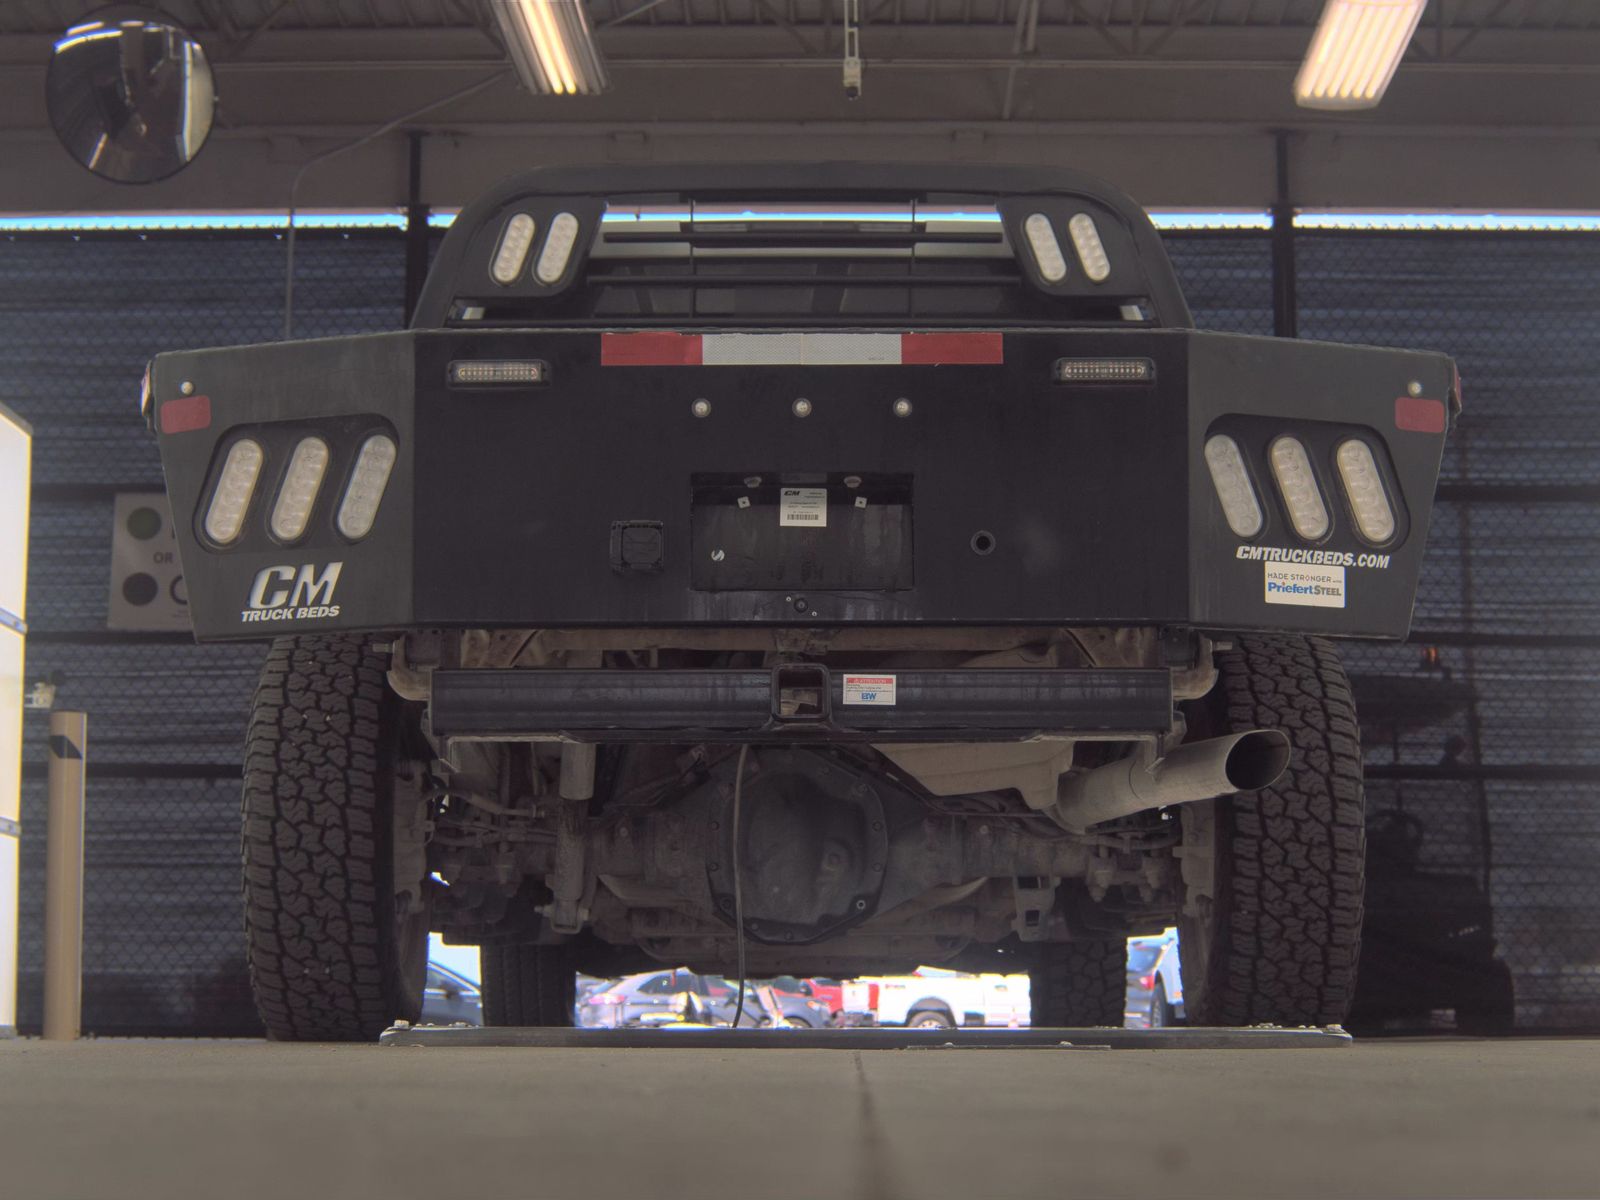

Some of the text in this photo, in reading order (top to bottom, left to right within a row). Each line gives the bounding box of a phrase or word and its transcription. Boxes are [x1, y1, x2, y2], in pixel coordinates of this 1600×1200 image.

[1236, 545, 1390, 569] CMTRUCKBEDS.COM
[249, 561, 343, 609] CM
[1290, 573, 1331, 583] STRONGER
[241, 605, 340, 622] TRUCK BEDS
